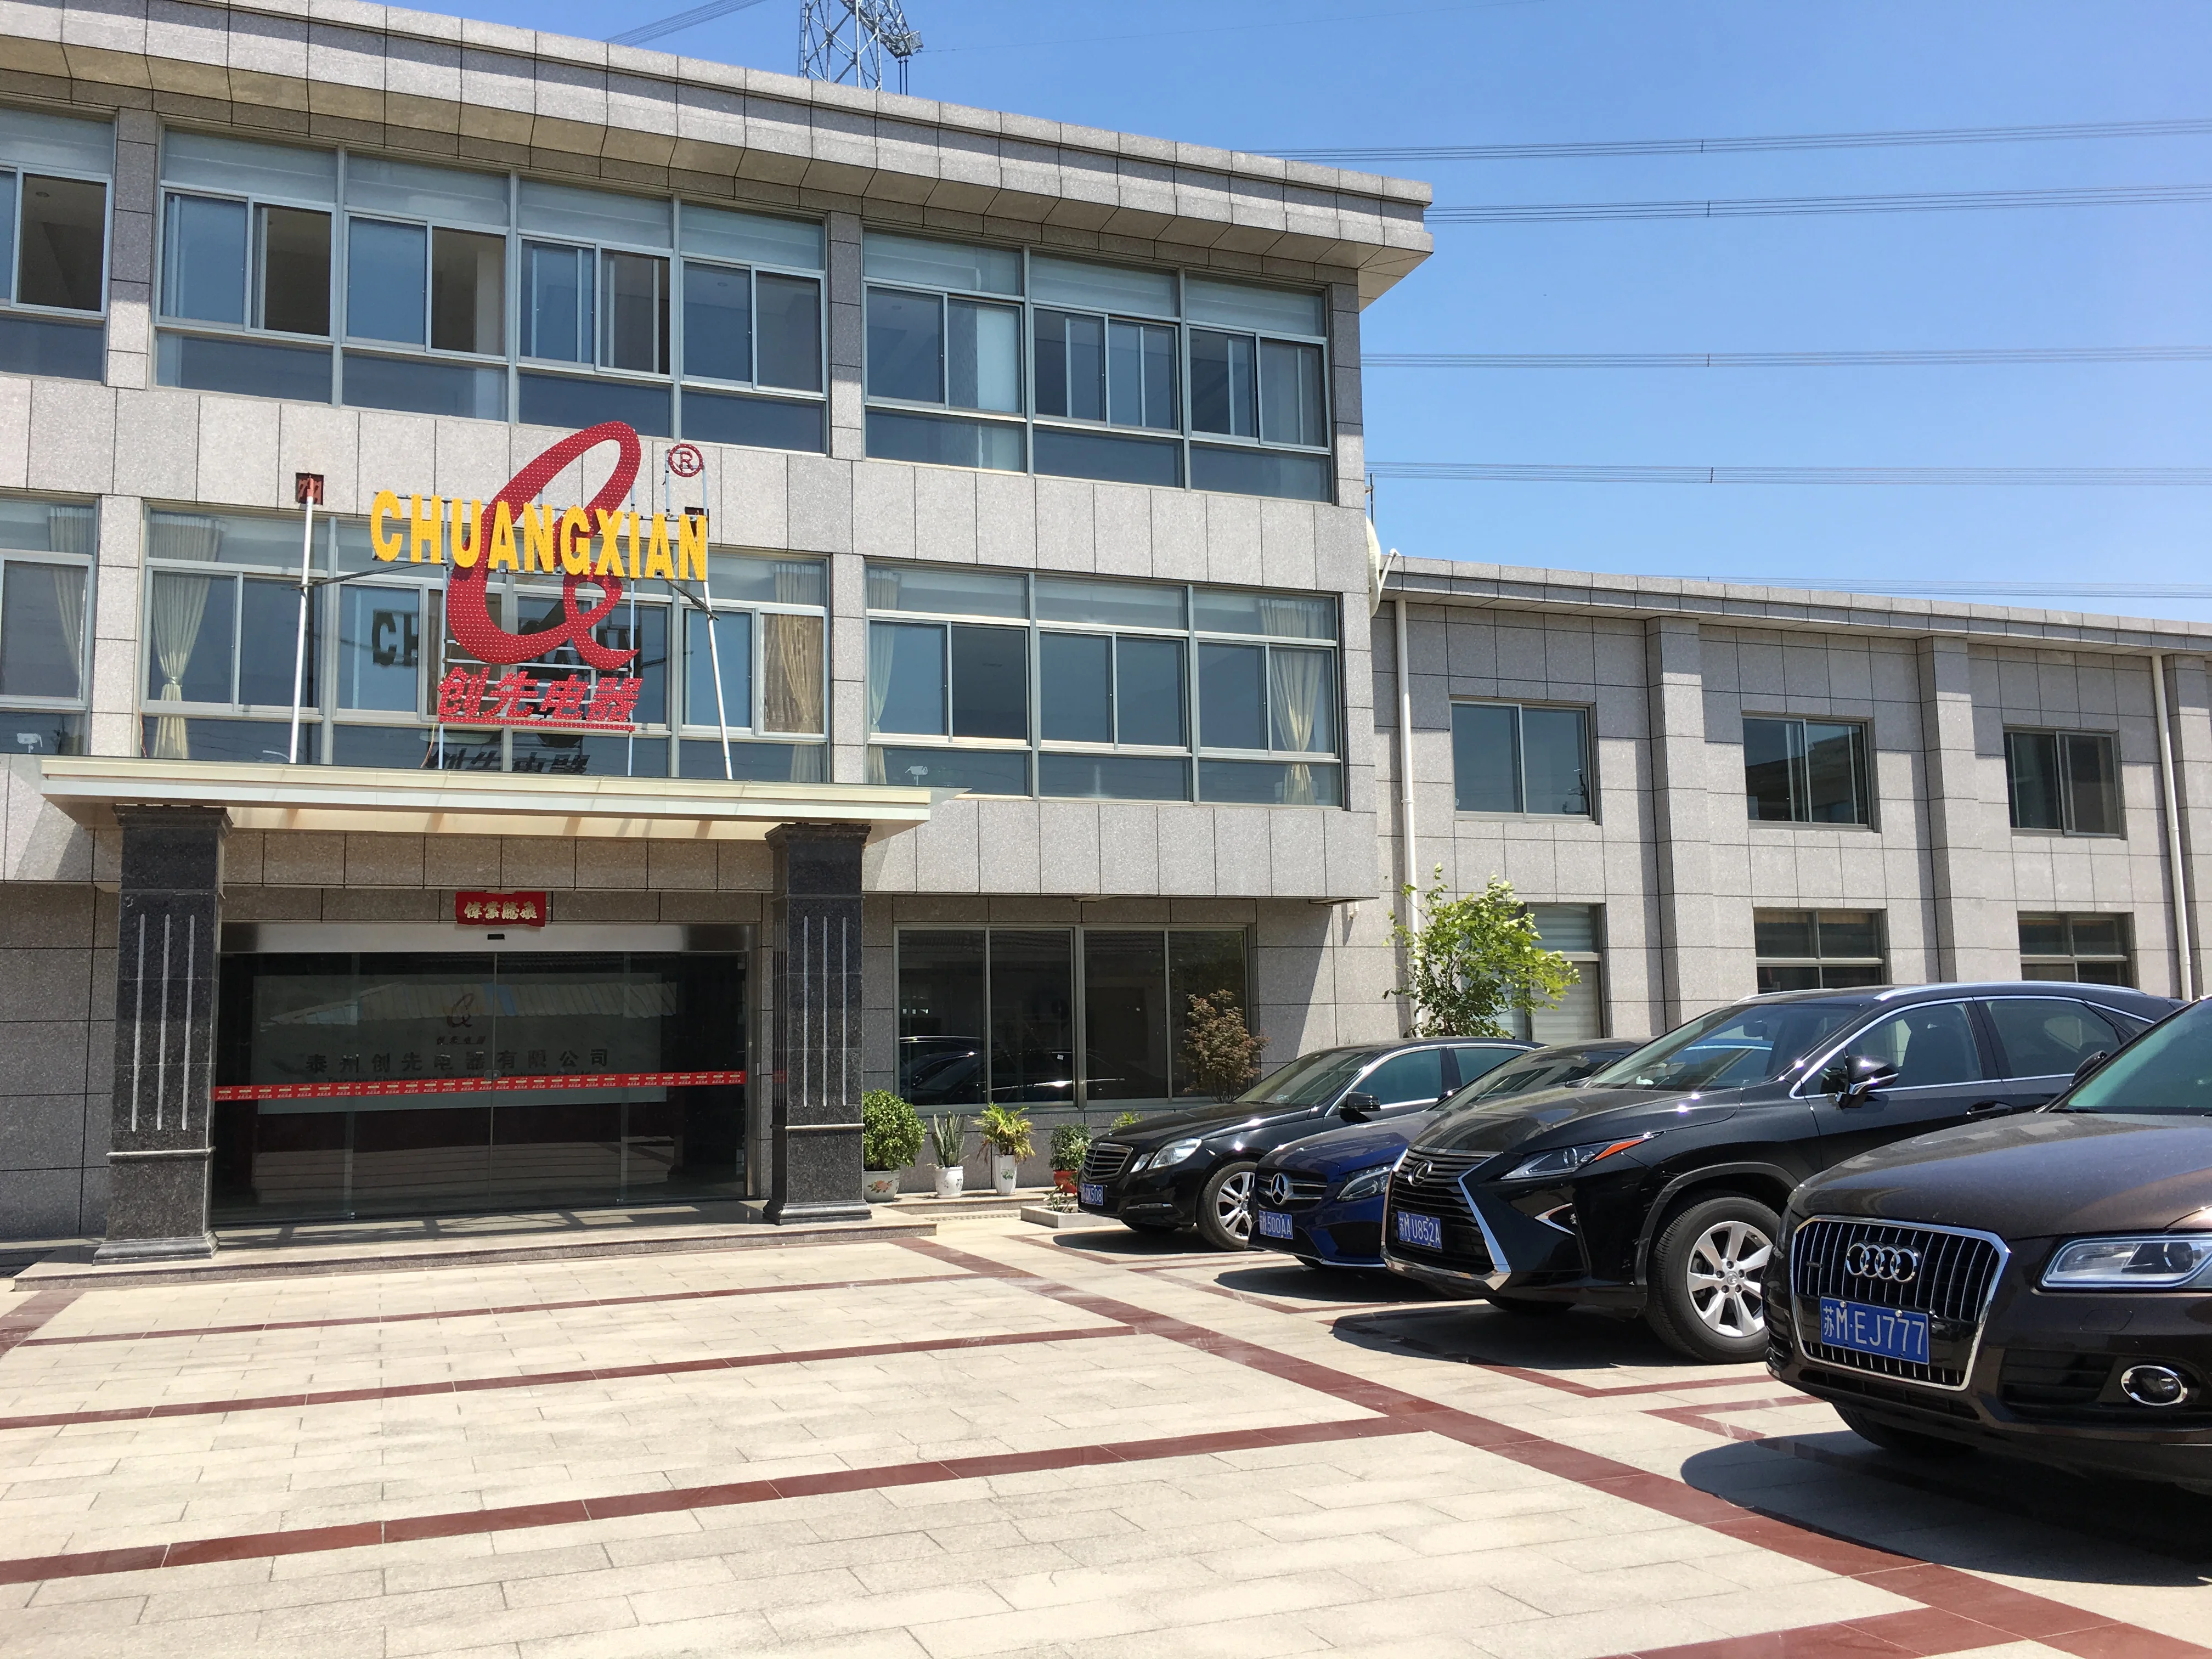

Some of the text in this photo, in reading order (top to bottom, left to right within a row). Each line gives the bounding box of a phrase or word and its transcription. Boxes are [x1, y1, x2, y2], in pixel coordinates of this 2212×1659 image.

[371, 490, 707, 582] CHUANGXIAN
[437, 667, 644, 724] 创先电器
[306, 1048, 608, 1074] 泰州创先电器有限公司
